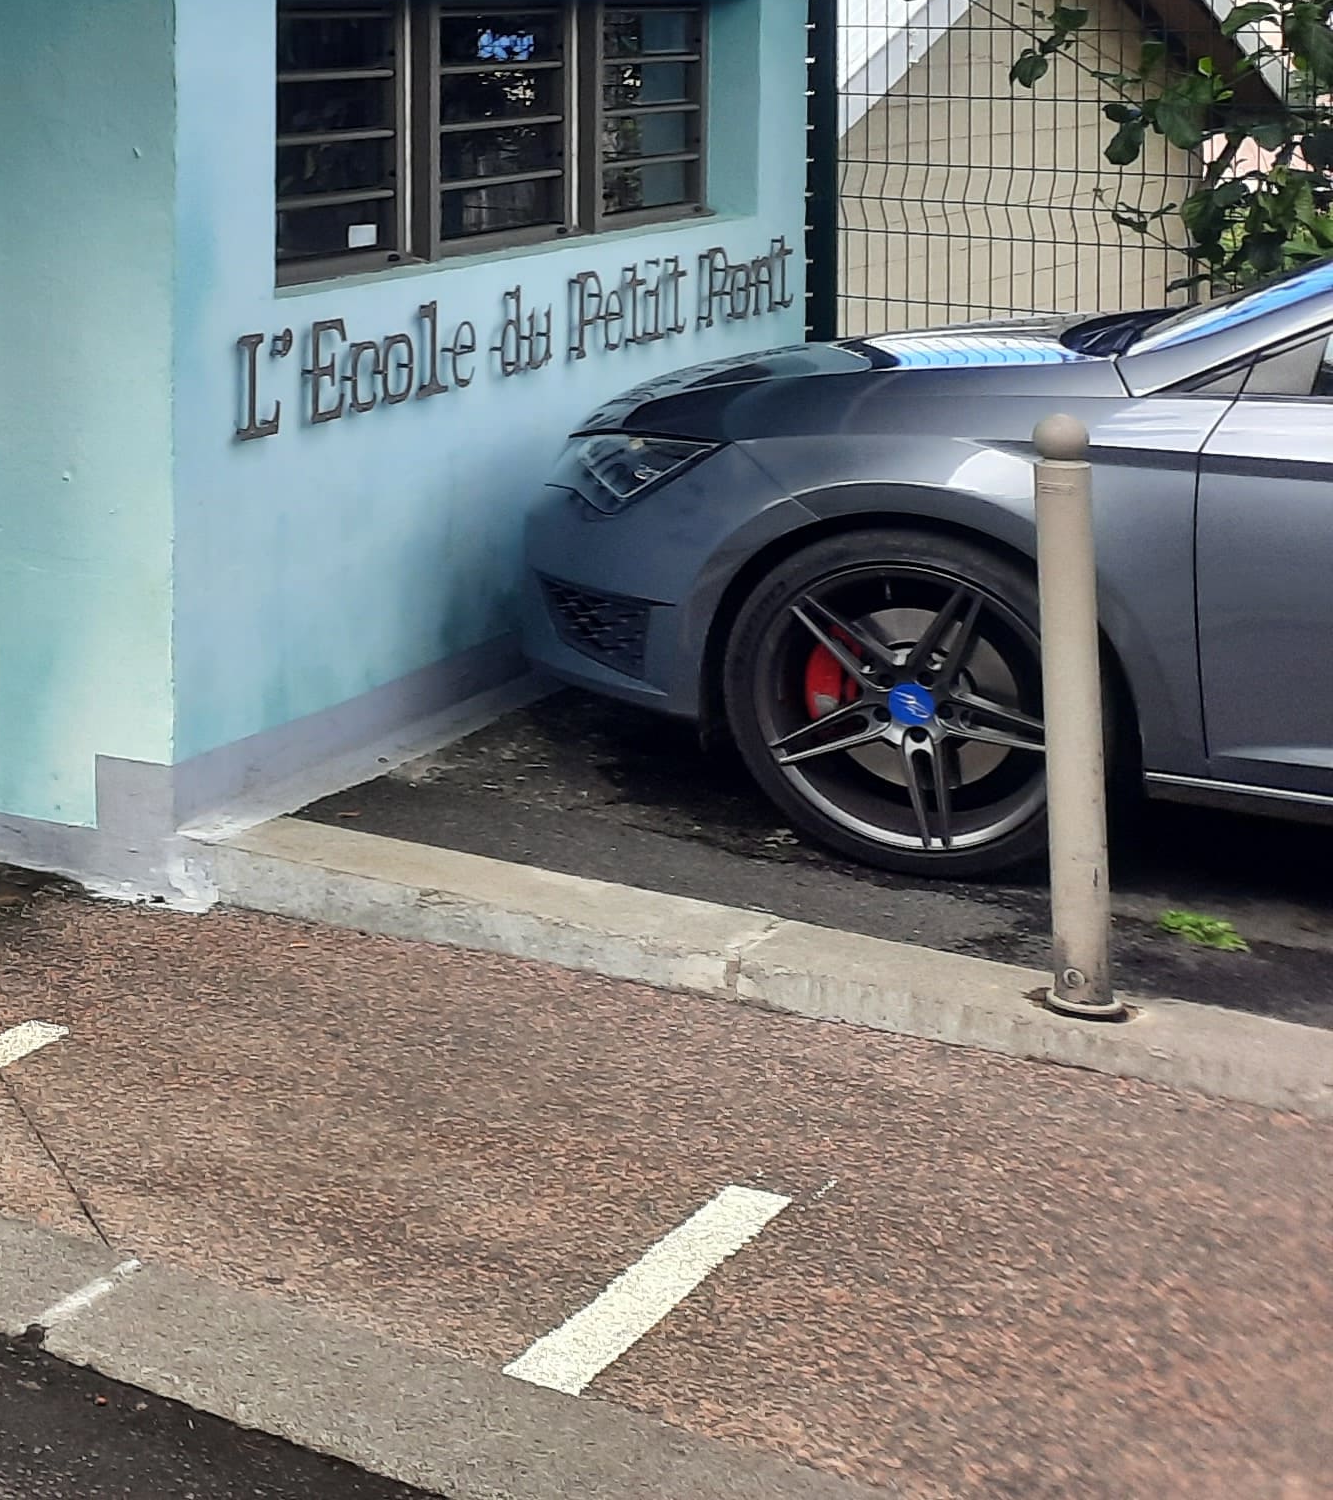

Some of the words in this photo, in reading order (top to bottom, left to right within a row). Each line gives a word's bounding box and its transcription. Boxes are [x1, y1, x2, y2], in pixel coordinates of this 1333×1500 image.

[235, 301, 476, 441] L'Ecole
[493, 285, 553, 377] du
[569, 257, 687, 360] Petit
[697, 236, 794, 328] Pont
